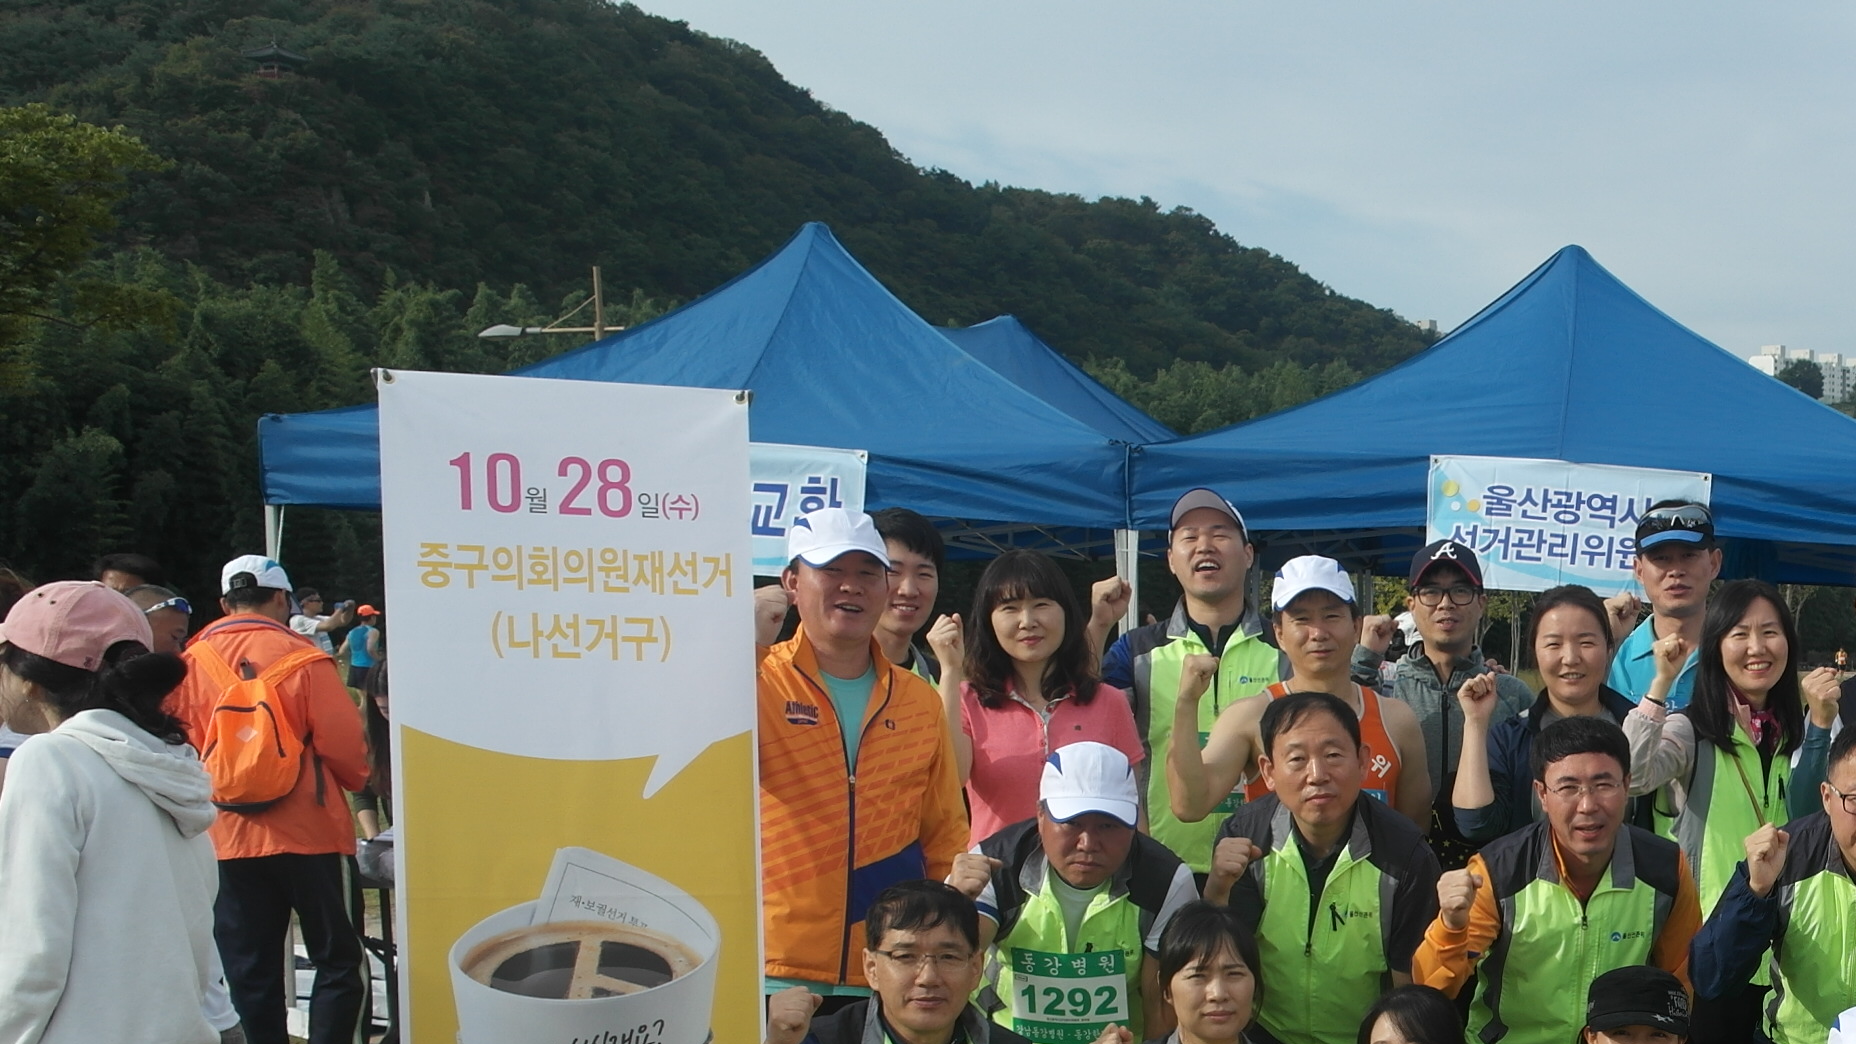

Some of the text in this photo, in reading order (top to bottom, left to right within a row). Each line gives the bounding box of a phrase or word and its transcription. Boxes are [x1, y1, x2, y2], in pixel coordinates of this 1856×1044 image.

[449, 452, 700, 521] 10월 28일(수)
[1482, 484, 1651, 528] 울산광역시
[417, 542, 732, 597] 중구의회의원재선거
[491, 610, 672, 663] (나선거구)
[1021, 984, 1119, 1017] 1292
